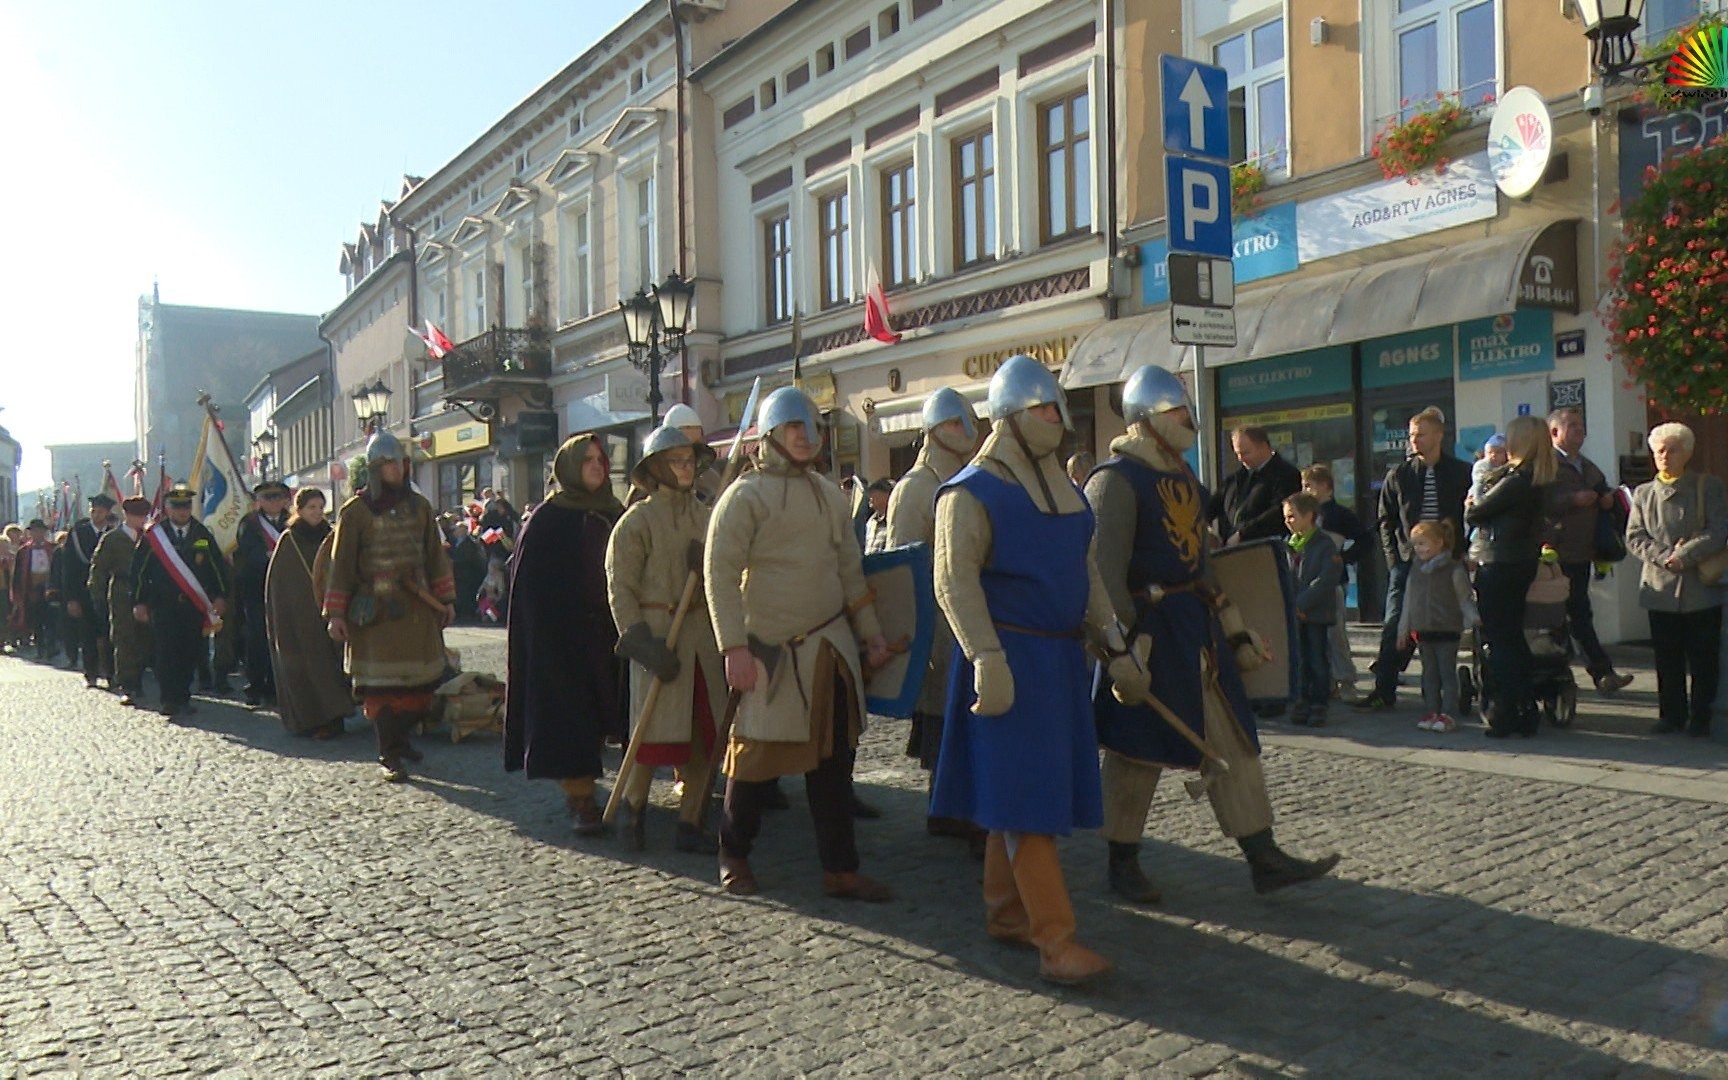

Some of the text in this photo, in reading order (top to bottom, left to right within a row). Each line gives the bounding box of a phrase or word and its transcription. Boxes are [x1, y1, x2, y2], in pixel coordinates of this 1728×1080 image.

[1183, 169, 1219, 242] P
[1352, 198, 1421, 229] AGD&RTV
[1425, 183, 1477, 209] AGNES
[1232, 231, 1279, 258] KTRO
[963, 335, 1078, 380] CUKRNI
[1379, 342, 1440, 368] AGNES
[1471, 343, 1541, 363] ELEKTRO
